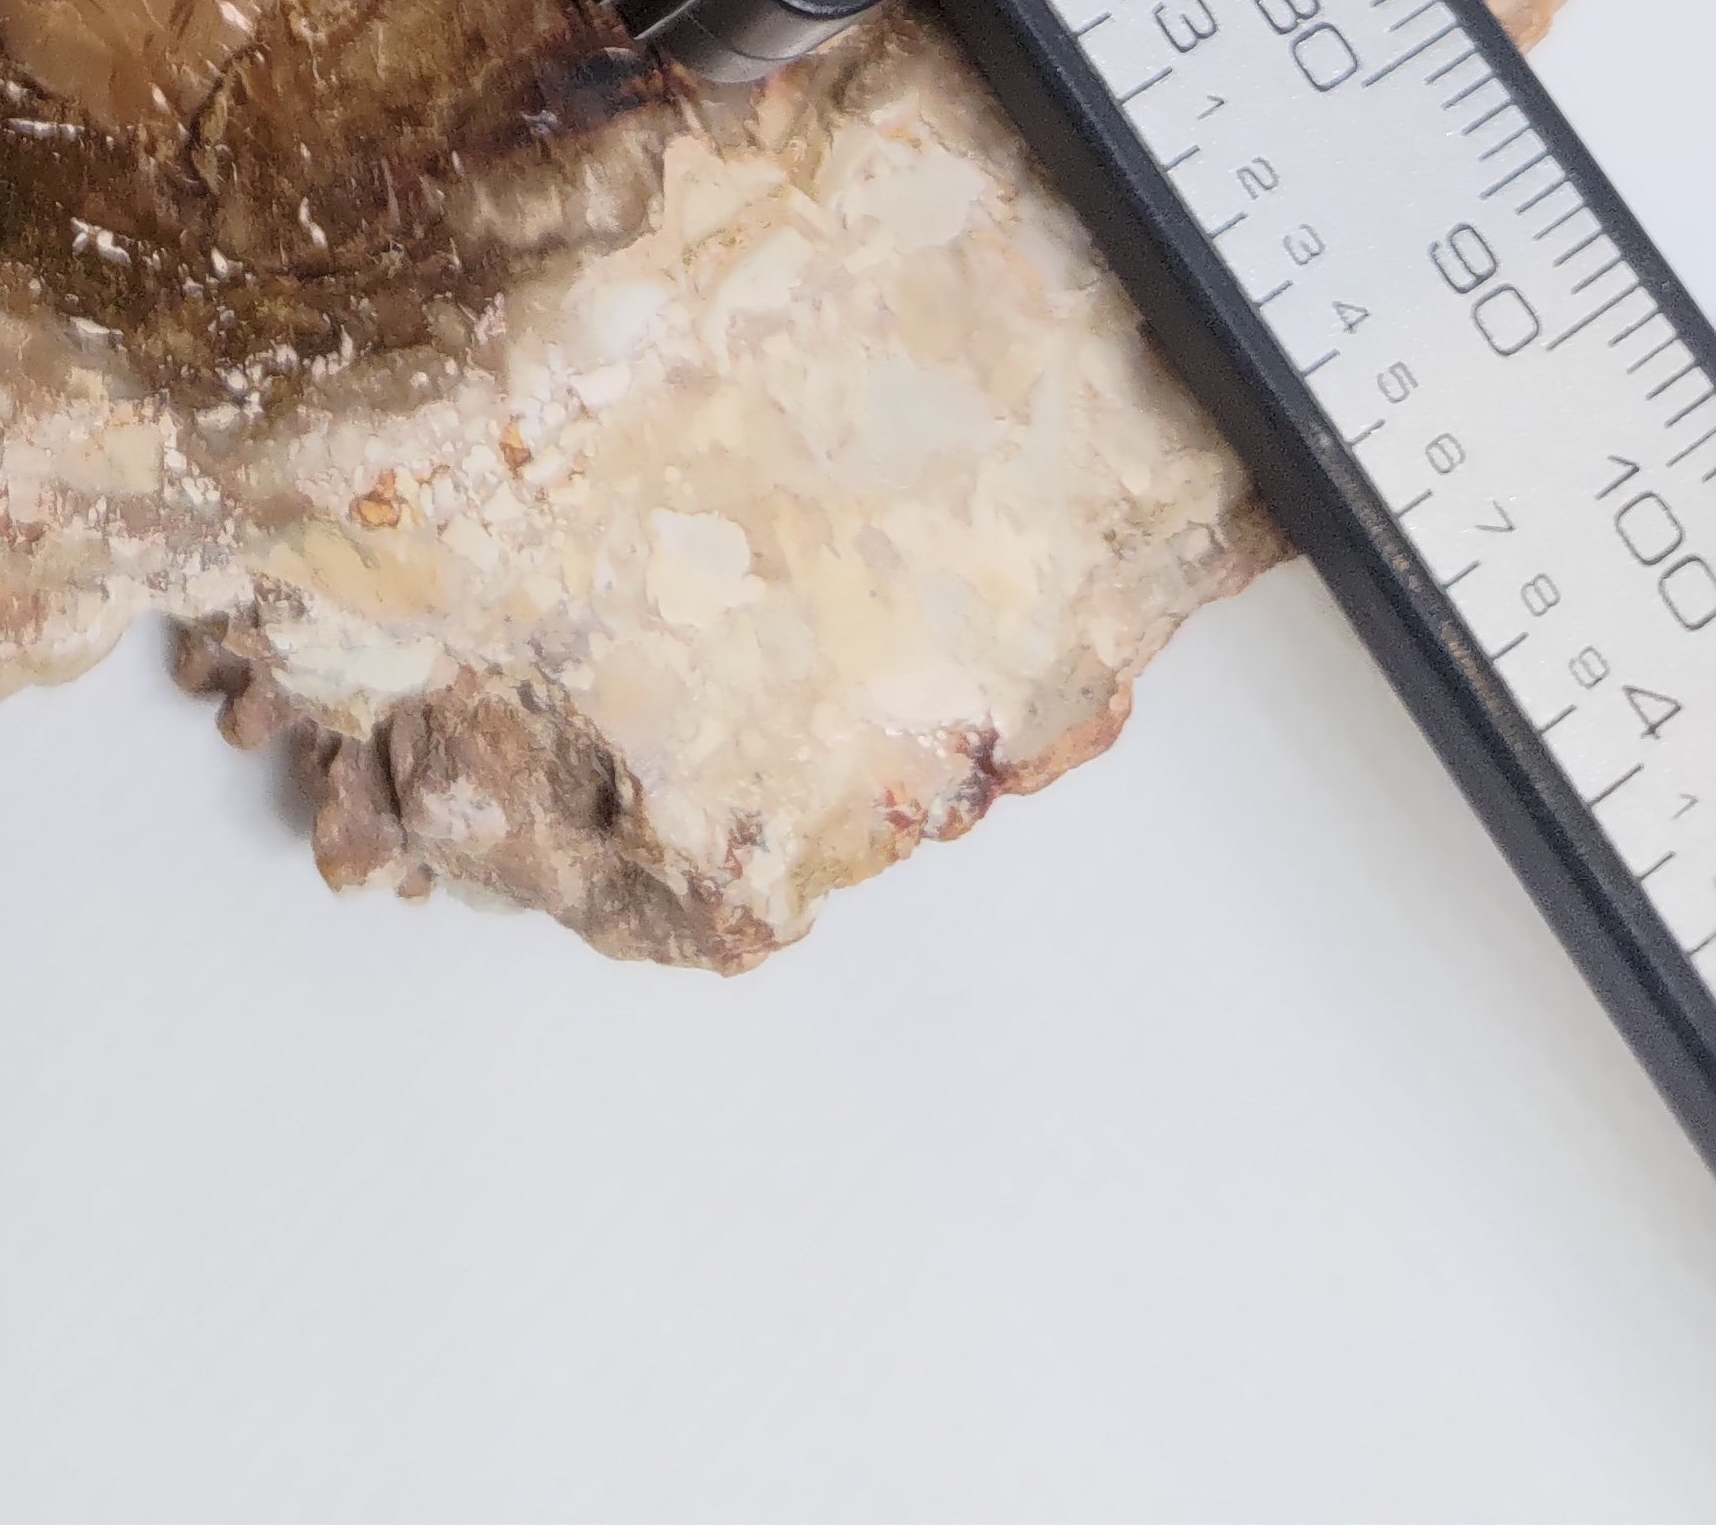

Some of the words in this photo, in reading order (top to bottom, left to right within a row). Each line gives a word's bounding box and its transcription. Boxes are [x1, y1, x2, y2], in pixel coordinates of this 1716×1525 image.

[1196, 94, 1226, 120] 1
[1236, 156, 1280, 200] 2
[1283, 223, 1326, 266] 3
[1331, 300, 1371, 334] 4
[1377, 360, 1419, 404] 5
[1424, 432, 1466, 475] 6
[1474, 500, 1517, 533] 7
[1520, 571, 1562, 619] 8
[1621, 684, 1683, 740] 4
[1428, 221, 1542, 357] 90
[1595, 453, 1716, 631] 100
